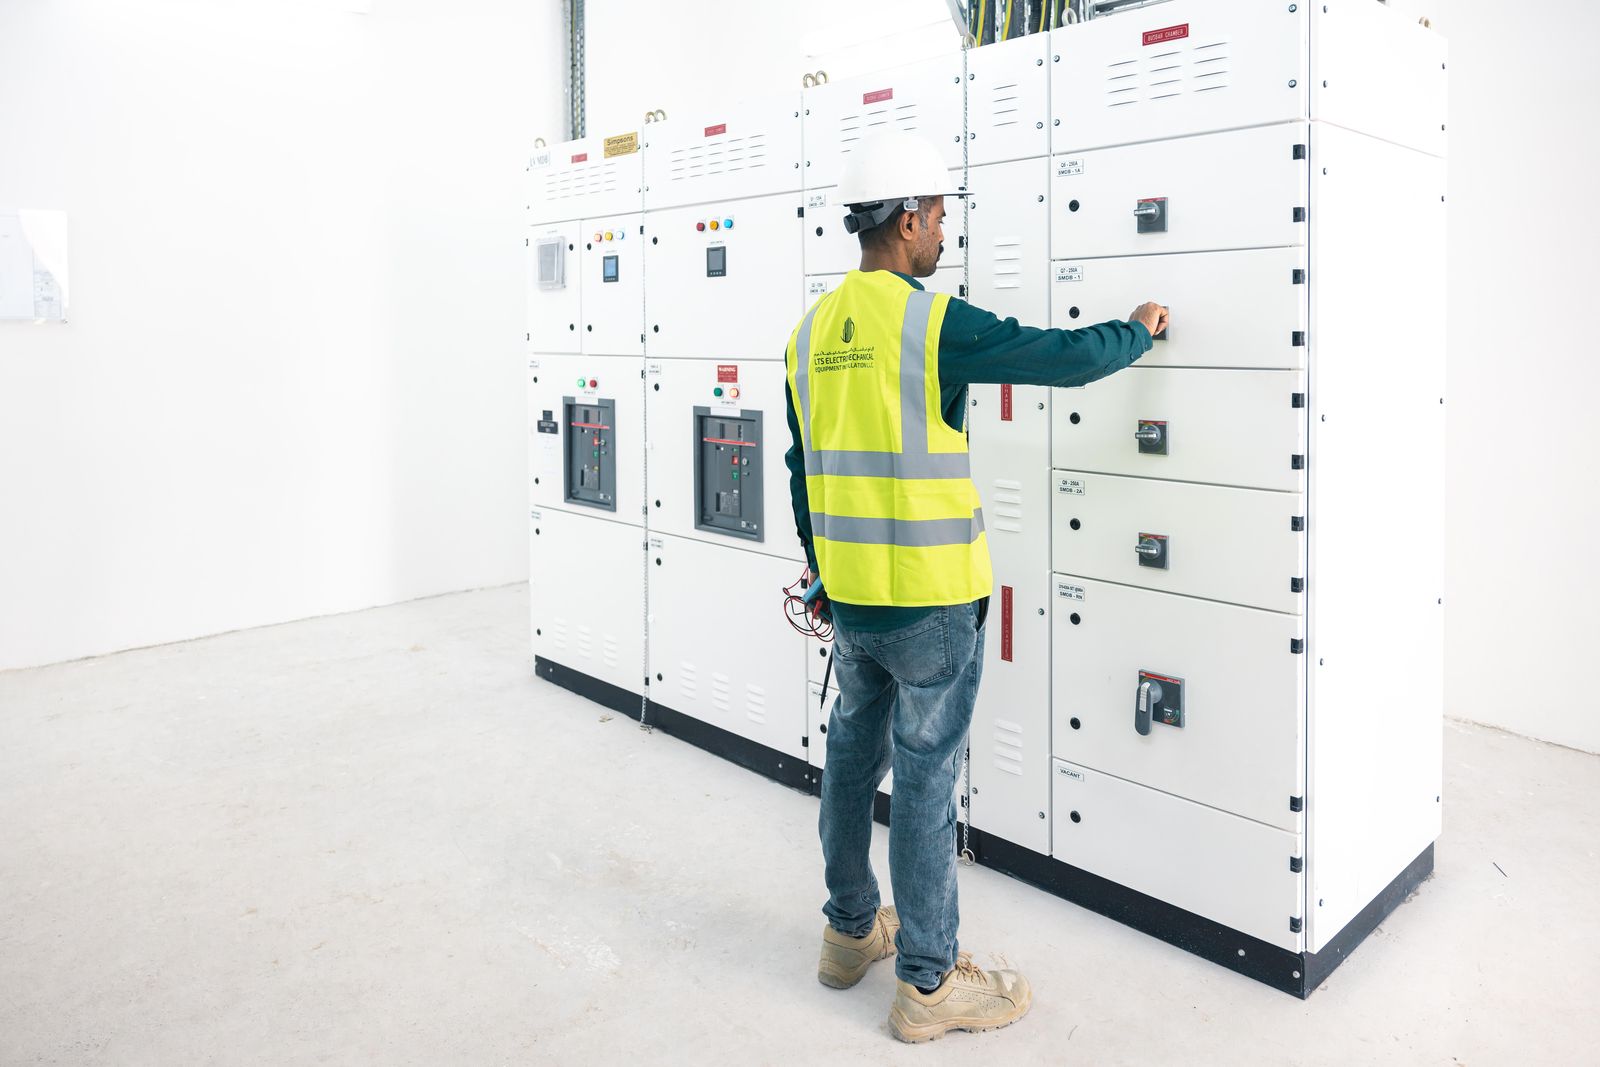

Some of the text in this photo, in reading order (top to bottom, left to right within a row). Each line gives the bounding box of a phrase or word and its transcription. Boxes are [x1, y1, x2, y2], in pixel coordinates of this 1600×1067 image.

[1164, 28, 1184, 38] CHAMBER
[607, 135, 634, 146] Simpsons
[814, 358, 825, 366] LTS
[1060, 768, 1081, 779] VACANT
